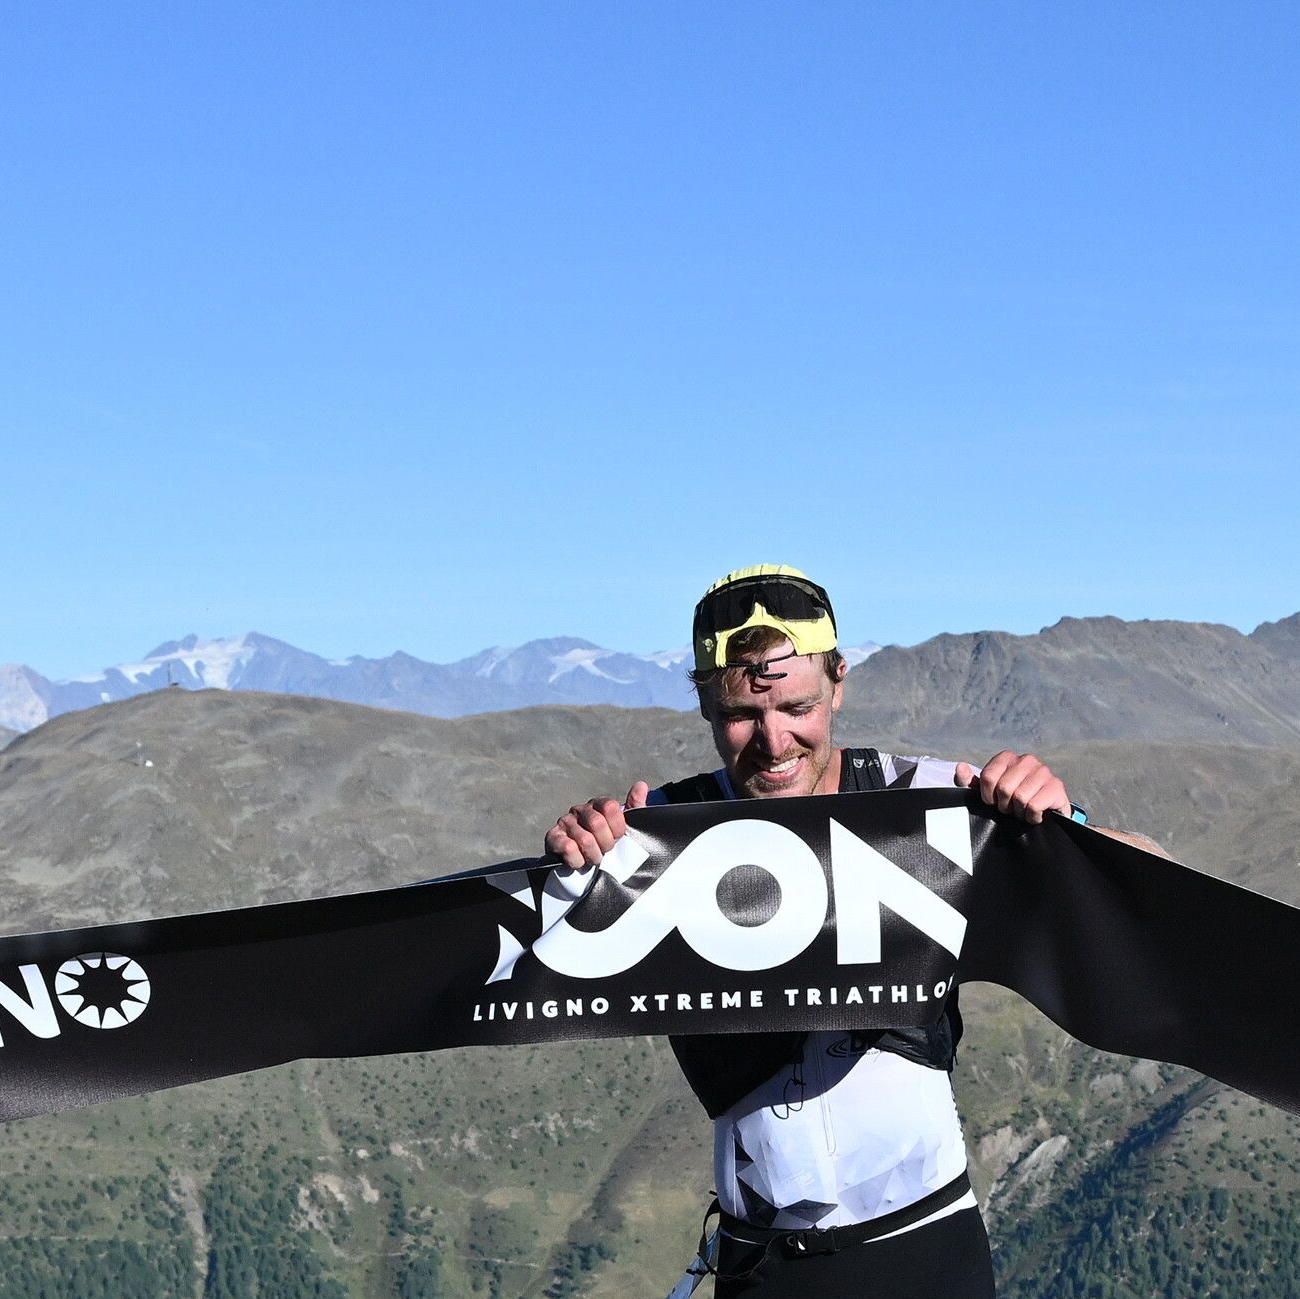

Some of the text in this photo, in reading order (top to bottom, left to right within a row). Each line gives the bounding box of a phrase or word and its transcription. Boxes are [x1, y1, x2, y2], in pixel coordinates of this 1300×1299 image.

[473, 973, 955, 1021] LIVIGNO XTREME TRIATHLO
